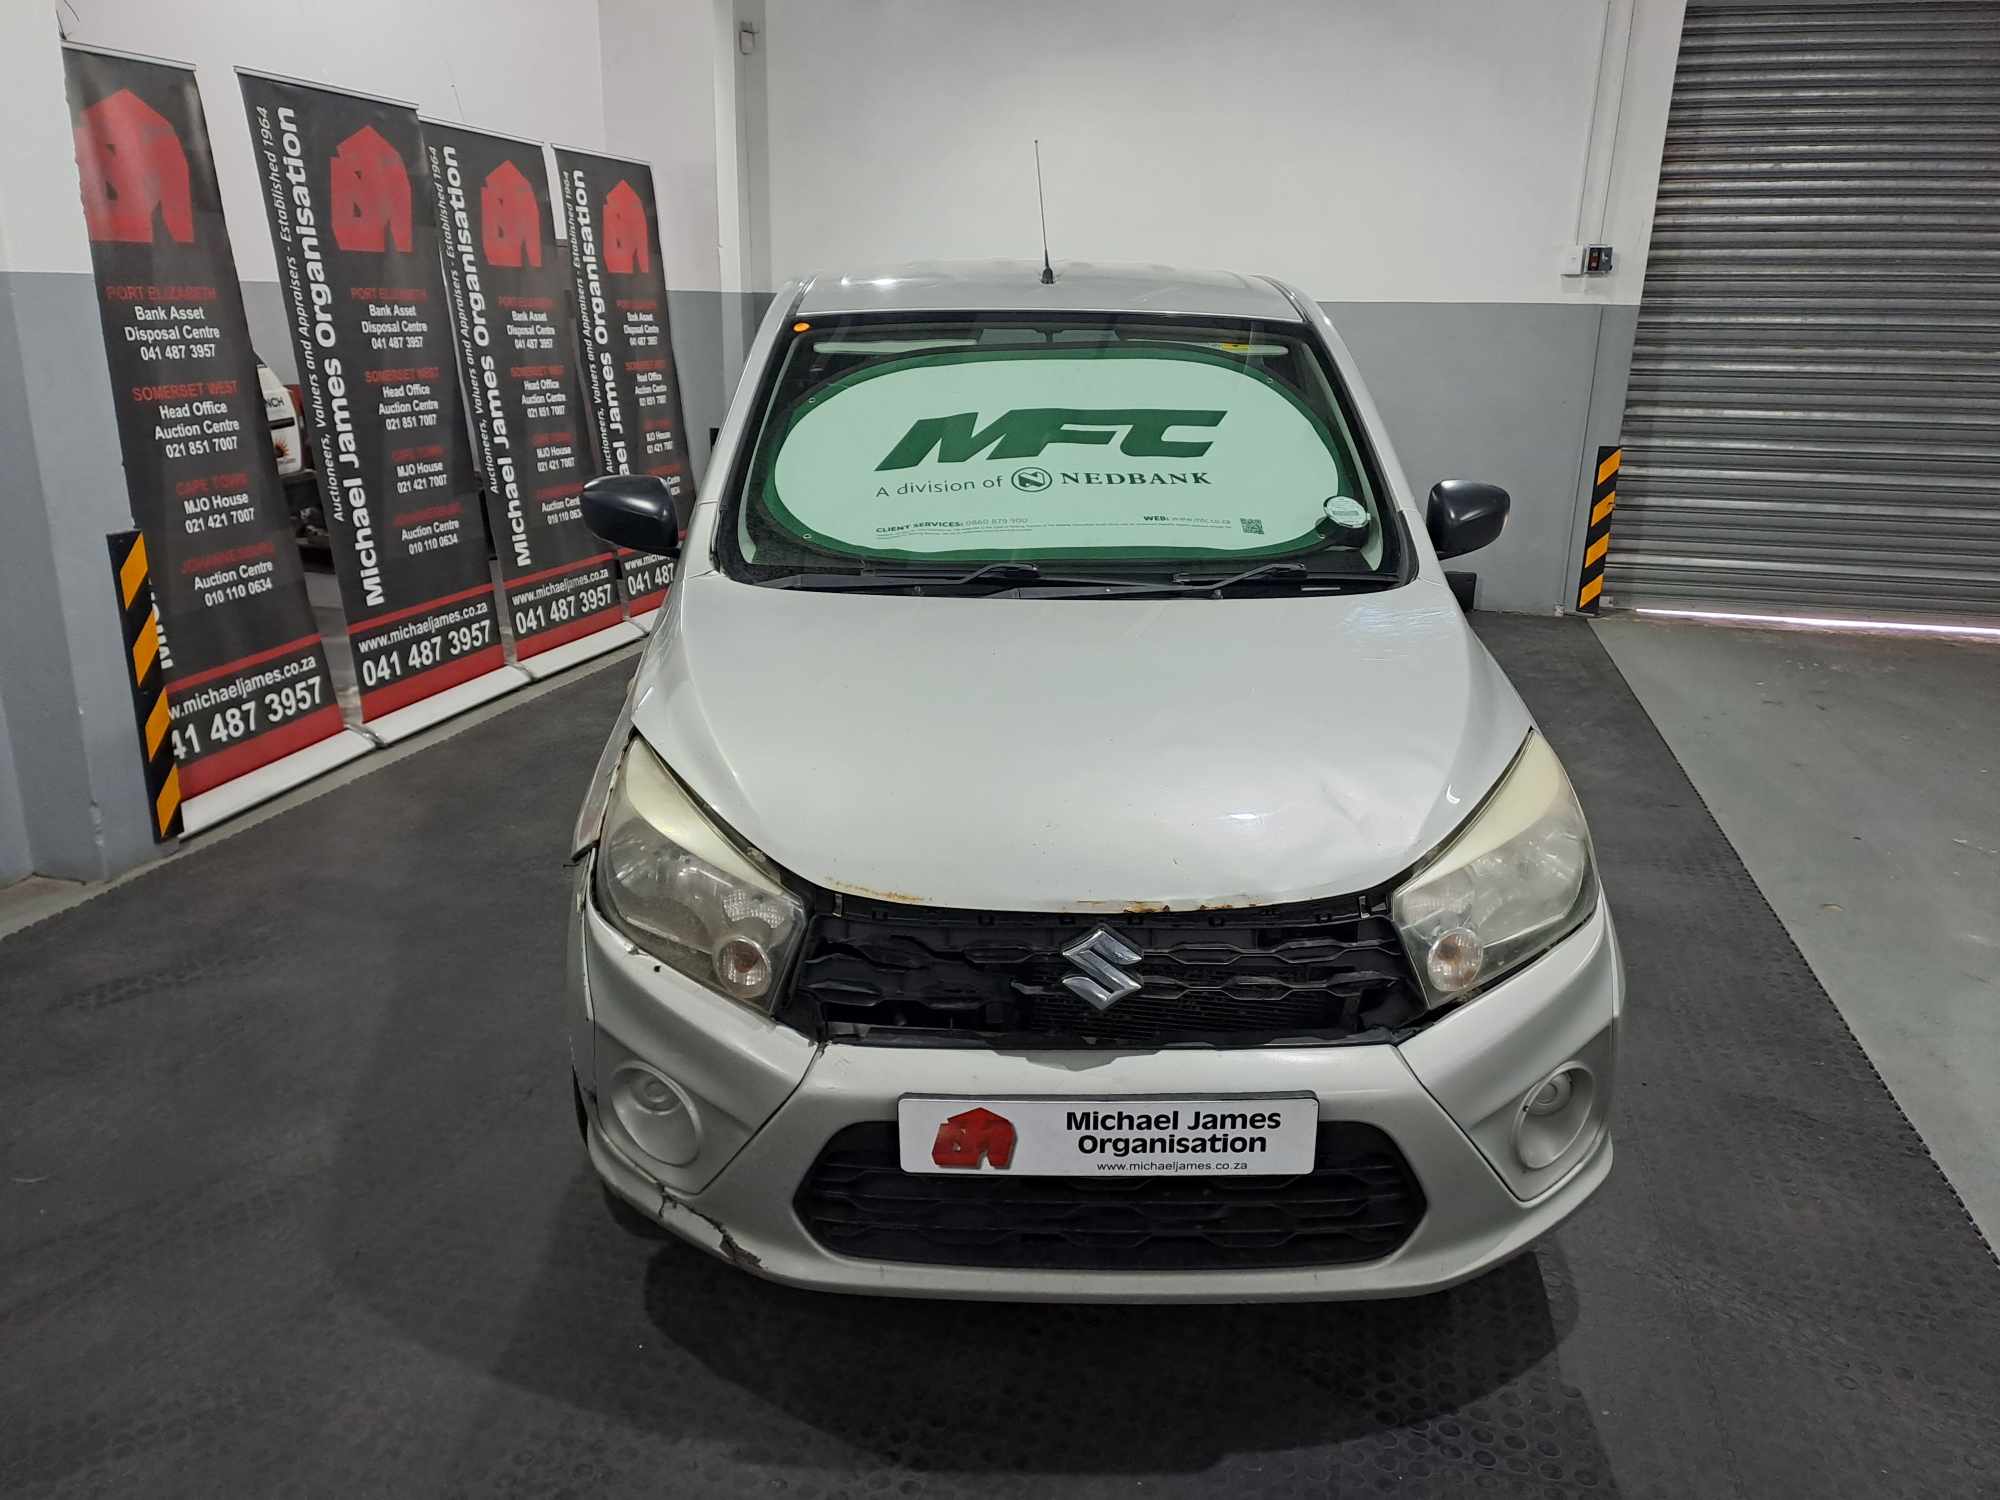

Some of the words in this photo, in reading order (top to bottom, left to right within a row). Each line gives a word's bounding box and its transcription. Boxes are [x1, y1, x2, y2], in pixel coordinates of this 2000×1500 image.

[256, 105, 274, 147] 1964
[268, 153, 292, 243] Established
[278, 107, 336, 348] Organisation
[434, 180, 456, 259] Established
[443, 146, 490, 347] Organisation
[573, 170, 609, 345] Organisation
[286, 253, 310, 338] Appraisers
[368, 304, 392, 317] Bank
[393, 304, 416, 317] Asset
[452, 269, 469, 336] Appraisers
[134, 305, 167, 320] Bank
[169, 306, 205, 320] Asset
[361, 320, 400, 335] Disposal
[401, 320, 428, 333] Centre
[124, 325, 180, 343] Disposal
[183, 325, 220, 339] Centre
[371, 337, 388, 350] 041
[388, 337, 403, 349] 487
[140, 345, 162, 361] 041
[165, 345, 186, 359] 487
[189, 344, 215, 358] 3957
[298, 340, 315, 369] and
[461, 338, 474, 366] and
[304, 372, 326, 428] Valuers
[382, 385, 405, 398] Head
[406, 383, 430, 396] Office
[467, 367, 485, 415] Valuers
[481, 355, 509, 449] James
[600, 353, 624, 434] James
[159, 404, 190, 419] Head
[192, 401, 228, 416] Office
[324, 357, 360, 469] James
[378, 402, 412, 416] Auction
[412, 399, 439, 411] Centre
[155, 423, 200, 440] Auction
[203, 419, 240, 434] Centre
[385, 418, 400, 431] 021
[402, 416, 417, 429] 851
[165, 443, 186, 458] 021
[188, 440, 210, 455] 851
[212, 436, 238, 452] 7007
[874, 408, 1228, 471] MFC
[396, 463, 416, 478] MJO
[416, 462, 443, 474] House
[477, 418, 499, 494] Auctioneers,
[319, 433, 344, 522] Auctioneers,
[397, 481, 412, 494] 021
[413, 477, 427, 490] 421
[876, 487, 890, 498] A
[897, 480, 975, 495] division
[983, 476, 1003, 489] of
[1060, 472, 1212, 485] NEDBANK
[184, 498, 210, 514] MJO
[212, 493, 248, 509] House
[497, 457, 531, 568] Michael
[185, 518, 205, 534] 021
[207, 513, 228, 529] 421
[230, 508, 255, 525] 7007
[401, 526, 432, 541] Auction
[433, 520, 460, 533] Centre
[876, 524, 911, 533] CLIENT
[343, 476, 385, 608] Michael
[408, 542, 423, 555] 010
[424, 538, 438, 551] 110
[194, 570, 237, 591] Auction
[239, 561, 273, 578] Centre
[511, 568, 608, 606] www.michaeljames.co.za
[627, 571, 650, 596] 041
[654, 563, 674, 586] 487
[204, 590, 225, 607] 010
[226, 584, 246, 601] 110
[248, 577, 273, 595] 0634
[515, 605, 545, 635] 041
[549, 595, 575, 622] 487
[579, 584, 611, 613] 3957
[358, 602, 488, 654] www.michaeljames.co.za
[362, 650, 401, 686] 041
[408, 636, 442, 669] 487
[448, 619, 490, 656] 3957
[210, 700, 255, 742] 487
[264, 676, 321, 723] 3957
[1066, 1111, 1179, 1131] Michael
[1187, 1111, 1281, 1131] James
[1078, 1134, 1267, 1157] Organisation
[1096, 1161, 1248, 1173] www.michaeljames.co.za
